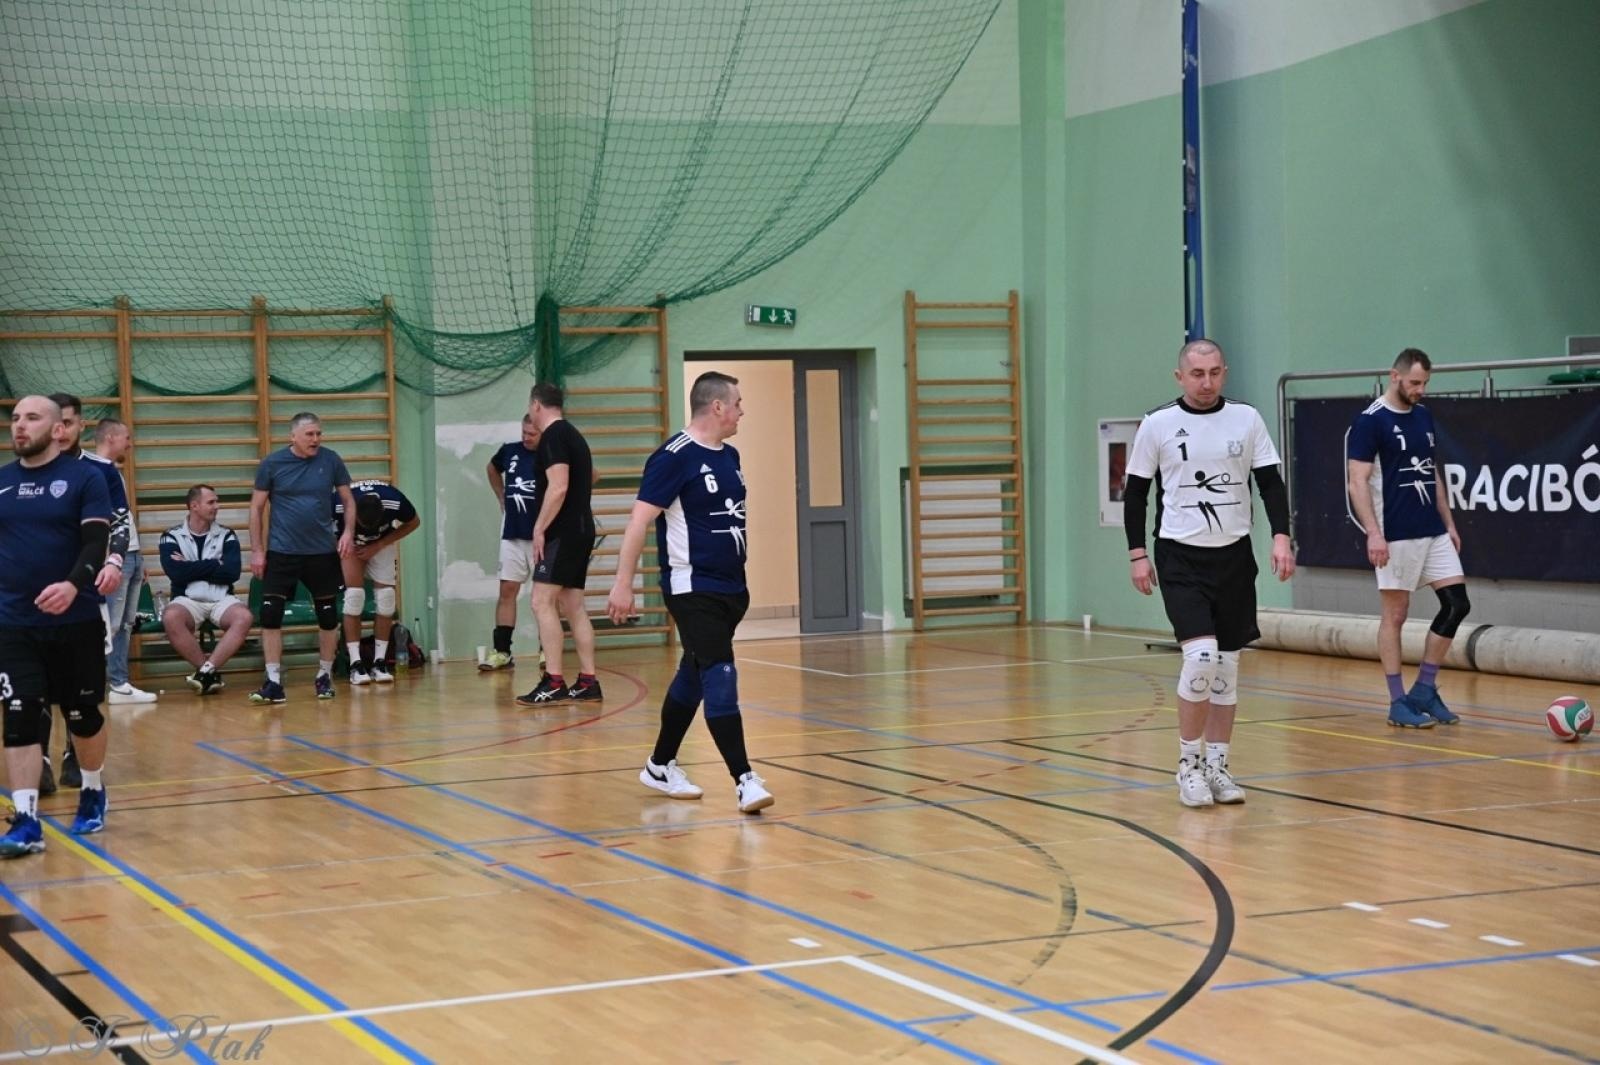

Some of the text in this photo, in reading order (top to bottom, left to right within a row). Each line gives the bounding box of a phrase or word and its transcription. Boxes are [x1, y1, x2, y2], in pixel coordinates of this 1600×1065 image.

[1177, 442, 1189, 461] 1
[508, 461, 518, 473] 2
[704, 474, 719, 494] 6
[1444, 444, 1600, 513] RACIBÓ
[0, 672, 13, 700] 3
